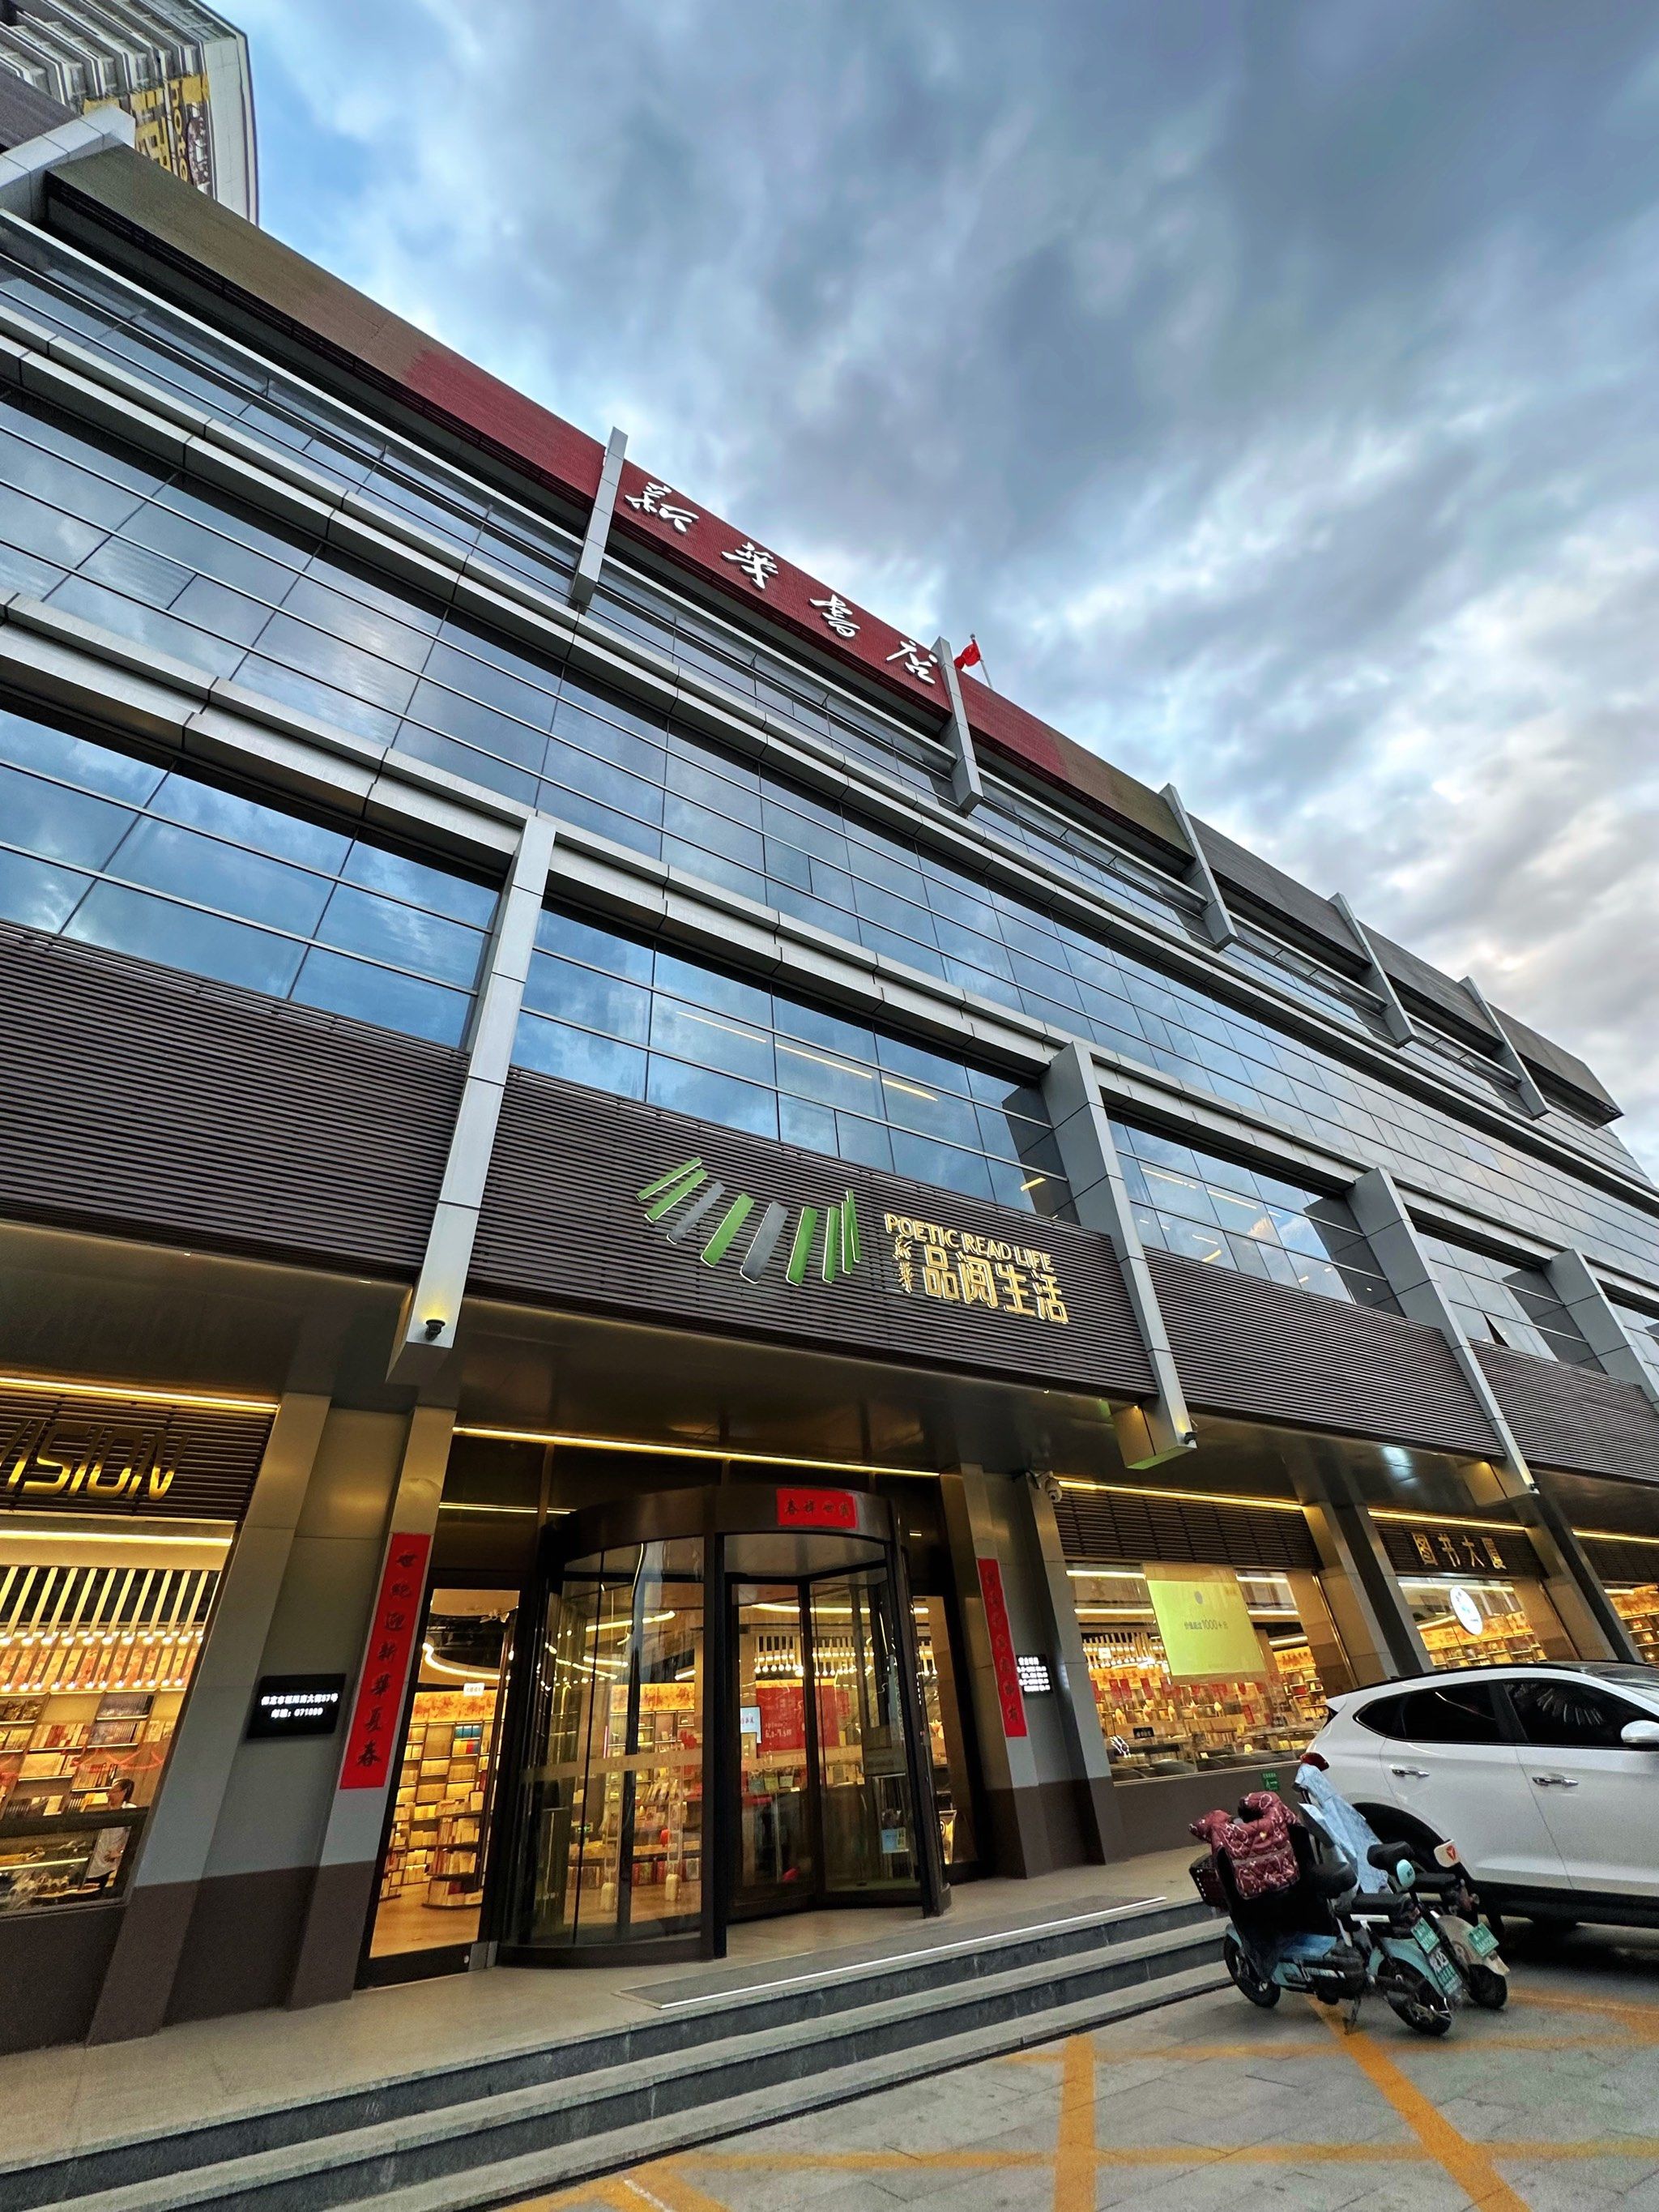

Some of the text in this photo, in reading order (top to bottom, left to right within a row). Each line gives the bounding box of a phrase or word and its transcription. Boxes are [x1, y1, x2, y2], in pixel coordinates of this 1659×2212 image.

[884, 1213, 1055, 1273] POETIC READ LIFE
[922, 1244, 1068, 1325] 品阅生活
[1411, 1531, 1507, 1570] 图书大厦
